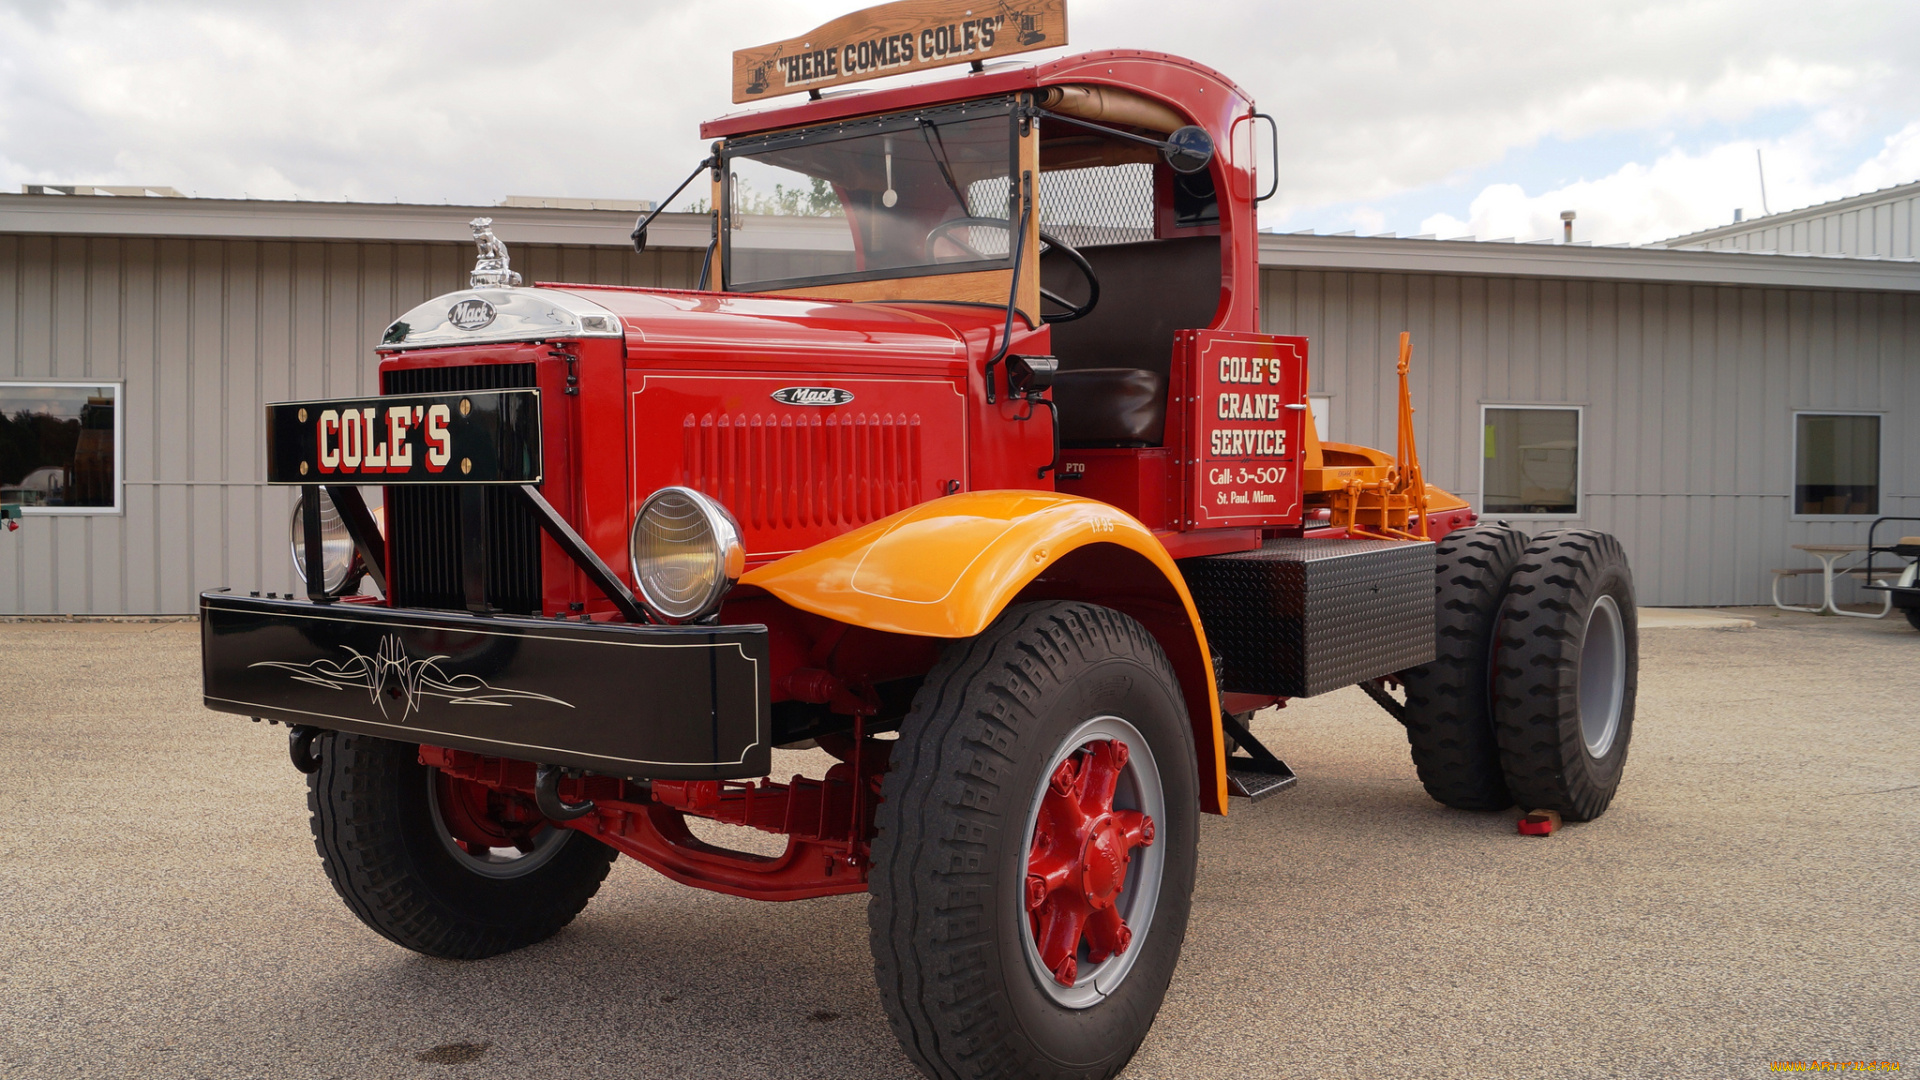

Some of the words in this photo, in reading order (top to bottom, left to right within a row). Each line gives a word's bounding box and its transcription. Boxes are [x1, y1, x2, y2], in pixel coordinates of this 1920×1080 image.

[776, 48, 838, 87] "HERE
[841, 33, 914, 77] COMES
[917, 15, 1005, 63] COLE'S"
[451, 302, 489, 325] Mack
[1219, 356, 1281, 385] COLE'S
[790, 388, 836, 403] Mack
[1218, 393, 1280, 421] CRANE
[317, 404, 451, 474] COLE'S
[1210, 429, 1287, 457] SERVICE
[1065, 462, 1085, 472] PTO
[1209, 468, 1233, 485] Call:
[1236, 467, 1287, 484] 3-507
[1216, 492, 1229, 505] St.
[1230, 491, 1250, 504] Paul,
[1252, 490, 1277, 503] Minn.
